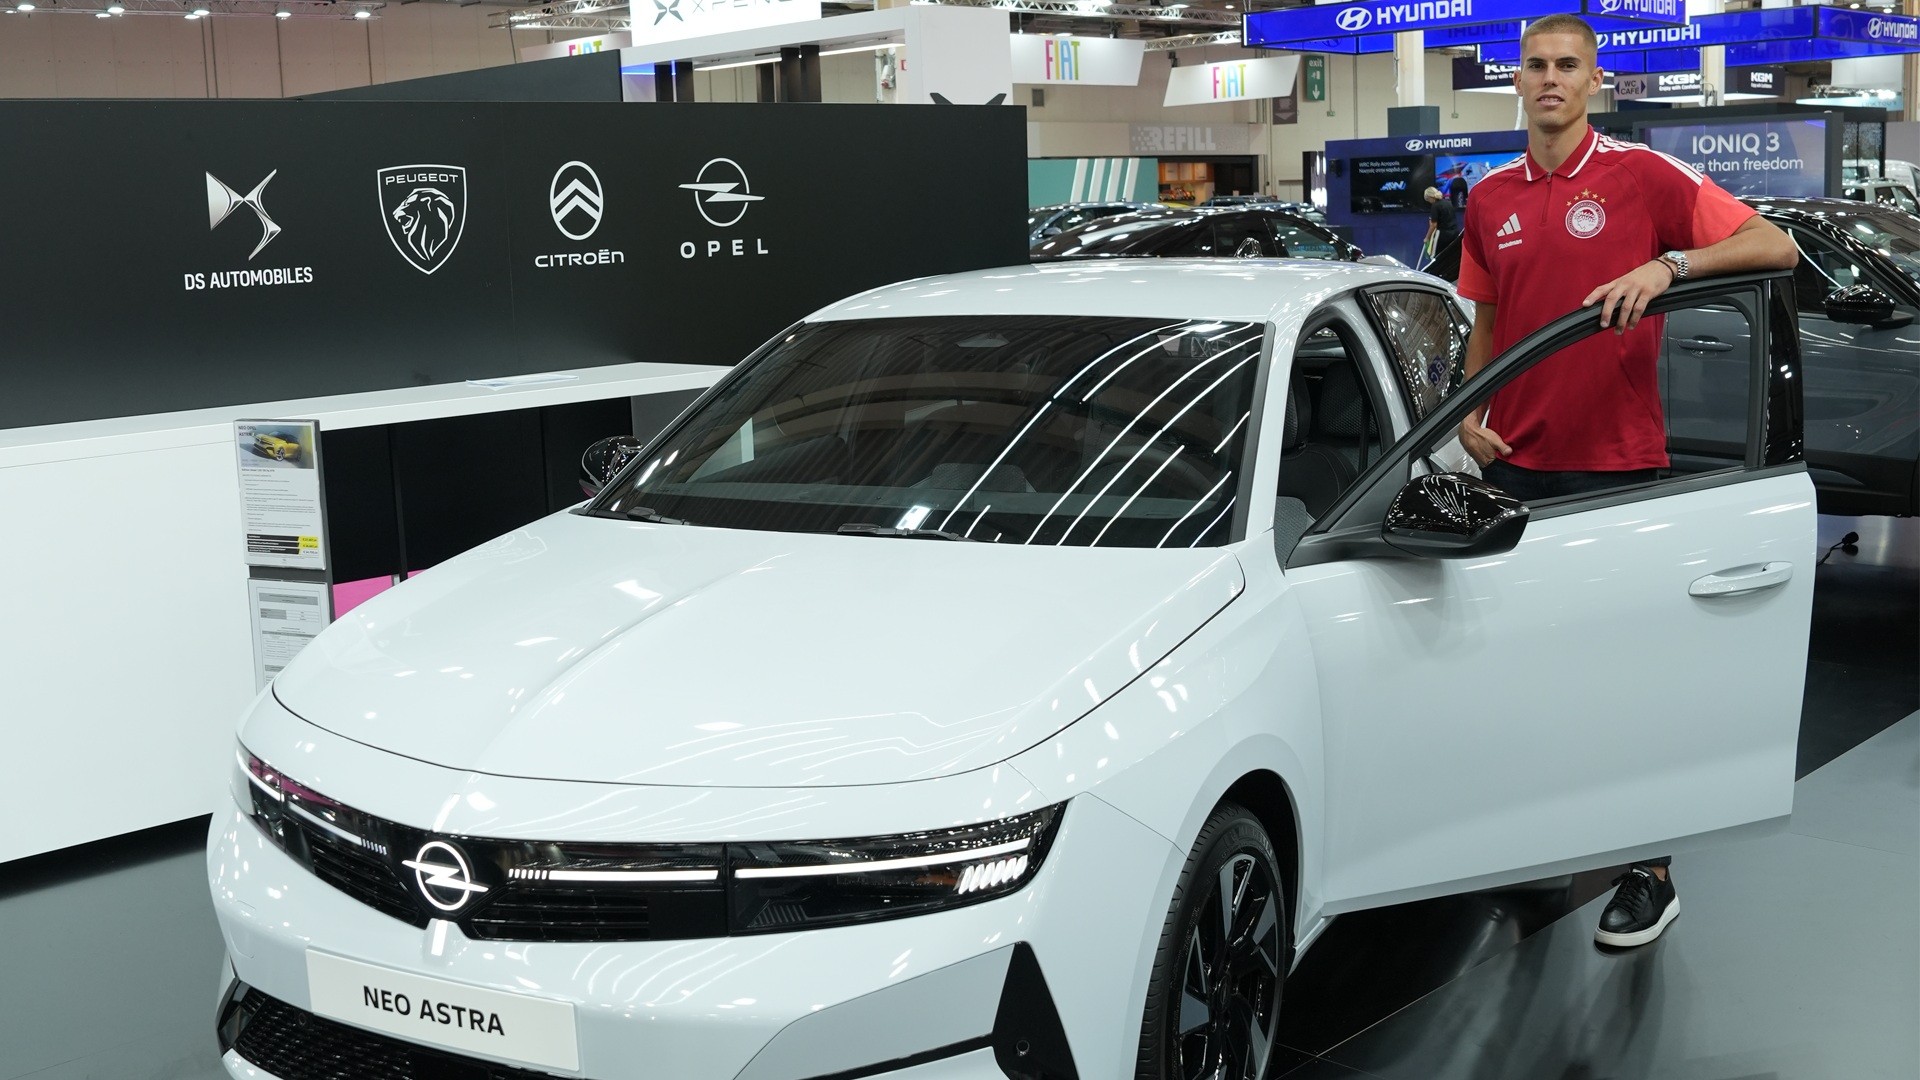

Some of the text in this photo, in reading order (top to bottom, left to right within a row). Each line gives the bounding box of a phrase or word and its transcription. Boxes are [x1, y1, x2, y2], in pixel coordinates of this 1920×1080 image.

[692, 0, 792, 14] XPE
[1377, 0, 1472, 25] HYUNDAI
[1624, 0, 1677, 16] HYUNDAI
[1612, 23, 1701, 46] HYUNDAI
[1883, 21, 1918, 39] HYUNDAI
[1045, 39, 1081, 81] FIAT
[1308, 58, 1323, 68] exit
[1484, 64, 1521, 74] KG
[1213, 63, 1246, 99] FIAT
[1658, 73, 1702, 86] KGM
[1750, 71, 1773, 83] KGM
[1147, 126, 1216, 151] REFILL
[1425, 138, 1472, 149] HYUNDAI
[1692, 132, 1780, 157] IONIQ 3
[1708, 159, 1740, 172] than
[1743, 157, 1804, 171] freedom
[385, 173, 459, 185] PEUGEOT
[679, 238, 769, 259] OPEL
[534, 249, 625, 268] CITROËN
[184, 267, 313, 290] DS AUTOMOBILES
[363, 985, 505, 1036] NEO ASTRA
